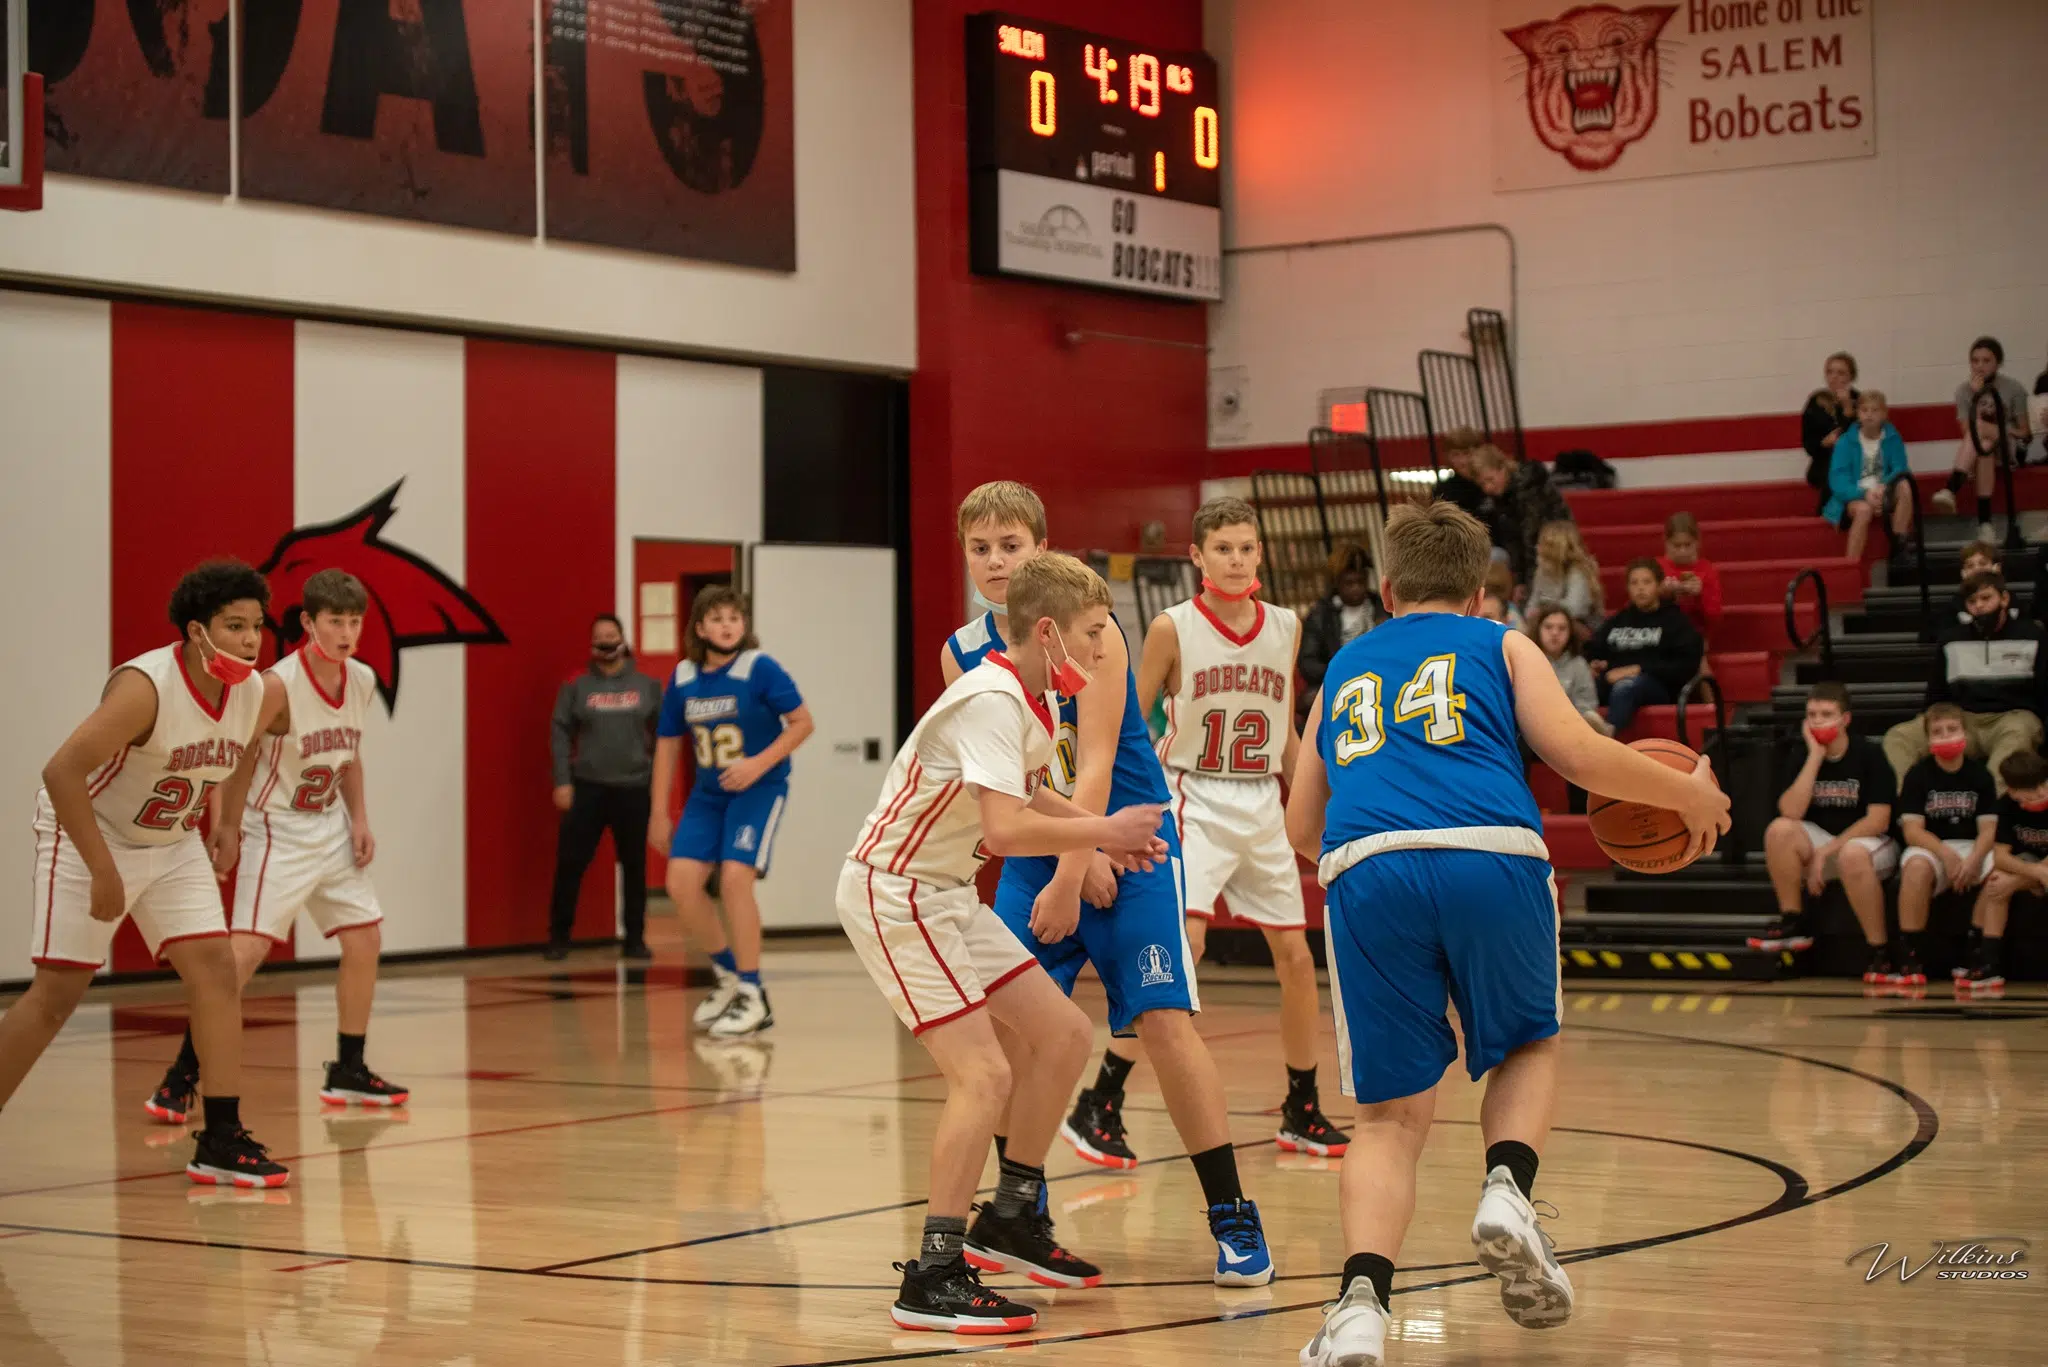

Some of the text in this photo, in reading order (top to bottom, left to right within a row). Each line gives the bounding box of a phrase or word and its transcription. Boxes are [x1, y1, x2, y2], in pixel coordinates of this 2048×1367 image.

[1687, 0, 1768, 34] Home
[1085, 44, 1160, 117] 4:19
[1700, 33, 1843, 80] SALEM
[1030, 69, 1056, 137] 0
[1688, 84, 1863, 145] Bobcats
[1194, 106, 1219, 169] 0
[1091, 150, 1136, 181] period
[1154, 151, 1166, 192] 1
[1112, 197, 1137, 234] GO
[1191, 664, 1286, 703] BOBCATS
[1332, 652, 1467, 767] 34
[1196, 708, 1271, 774] 12
